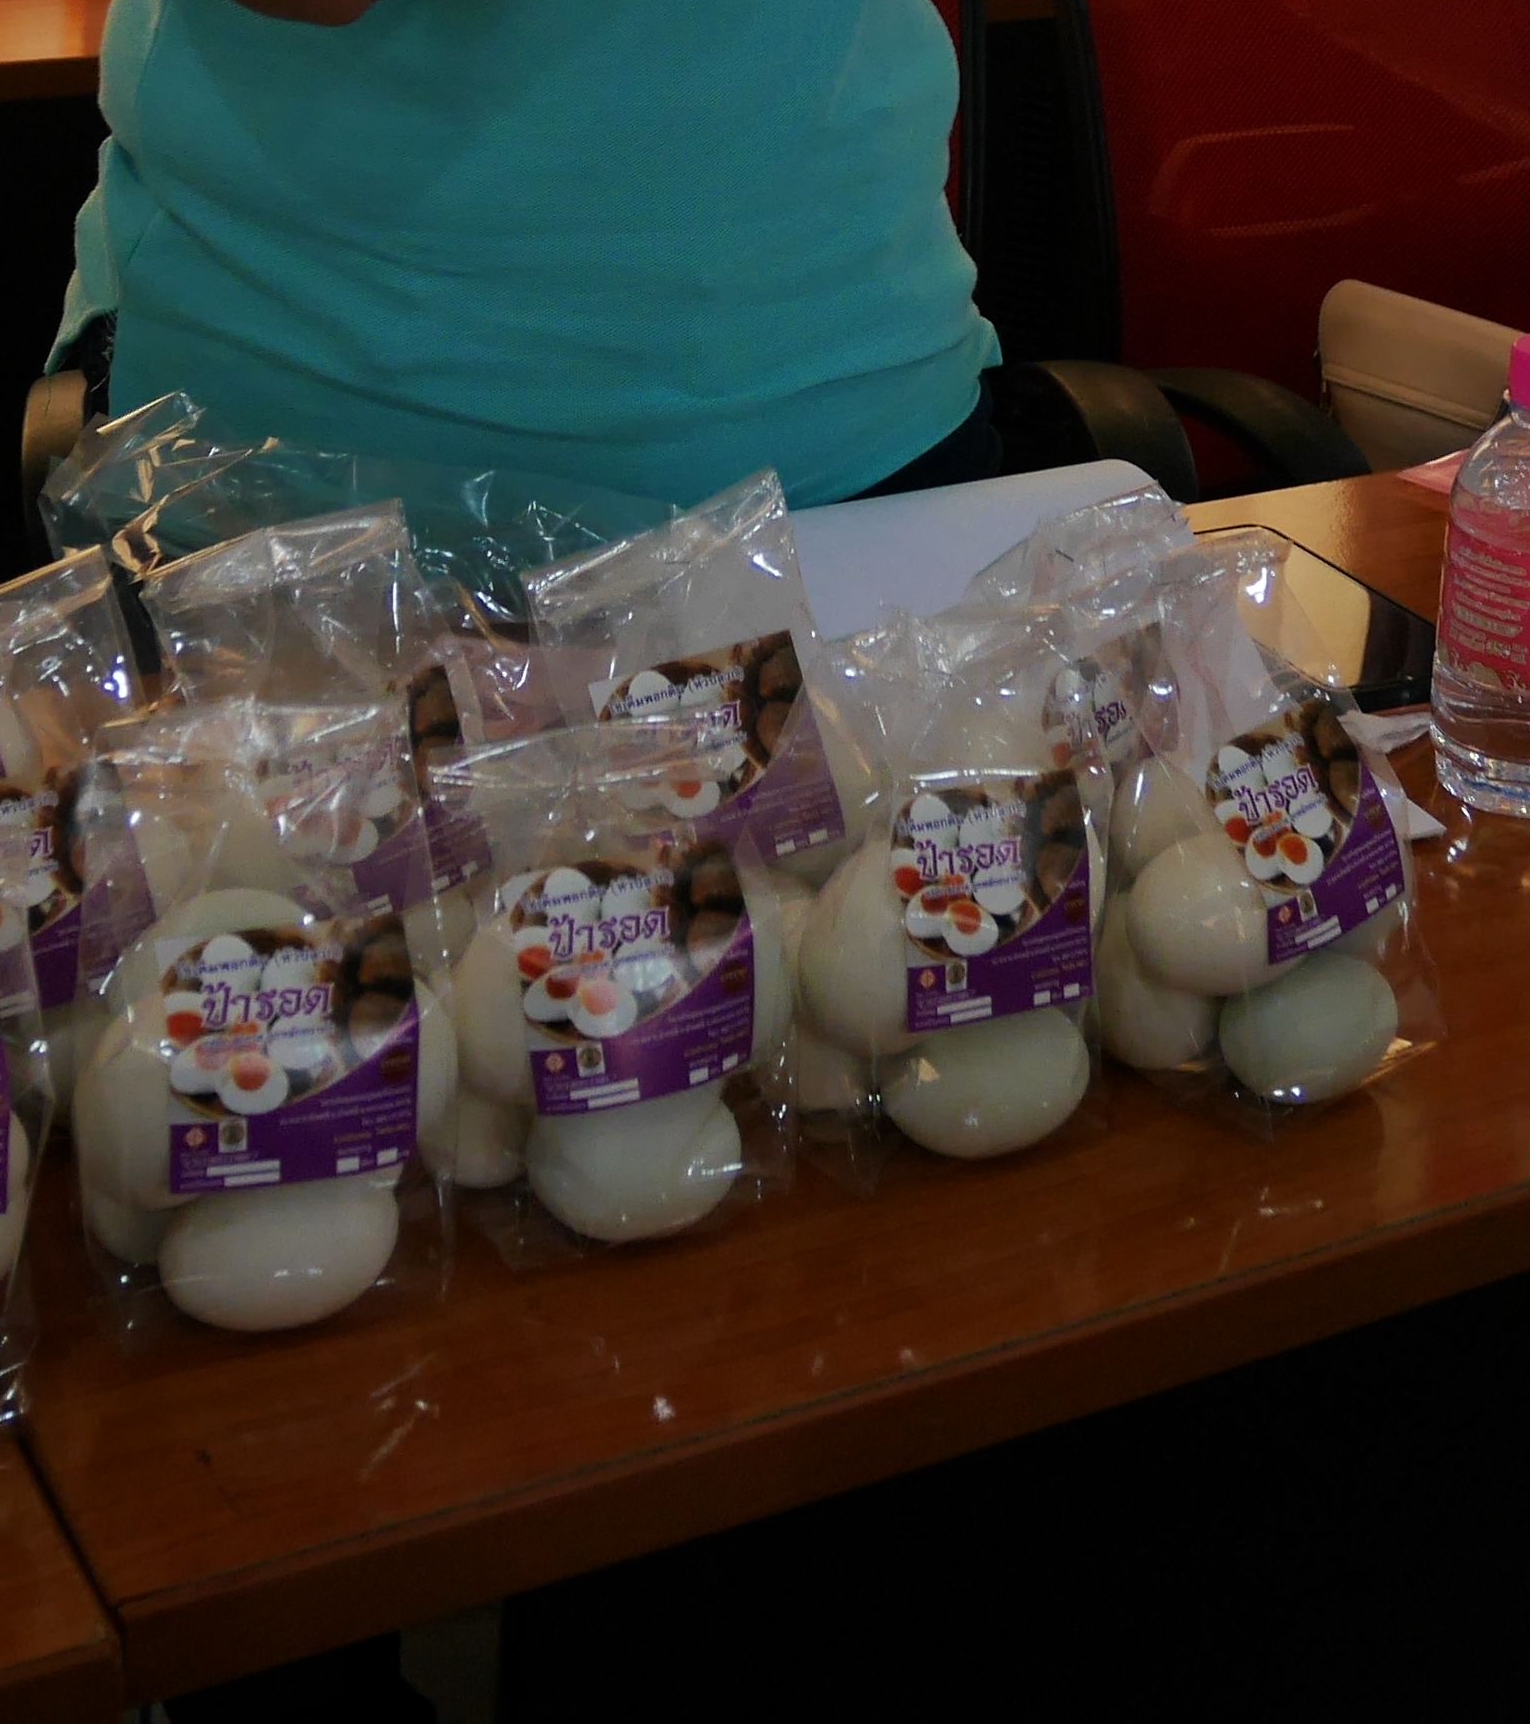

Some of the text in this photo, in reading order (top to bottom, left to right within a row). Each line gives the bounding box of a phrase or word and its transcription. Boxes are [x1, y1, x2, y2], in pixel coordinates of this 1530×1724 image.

[1233, 764, 1319, 824] ป้ารอด
[915, 837, 1021, 881] ป้ารอด
[549, 906, 669, 959] ป้ารอด
[202, 981, 333, 1028] ป้ารอด
